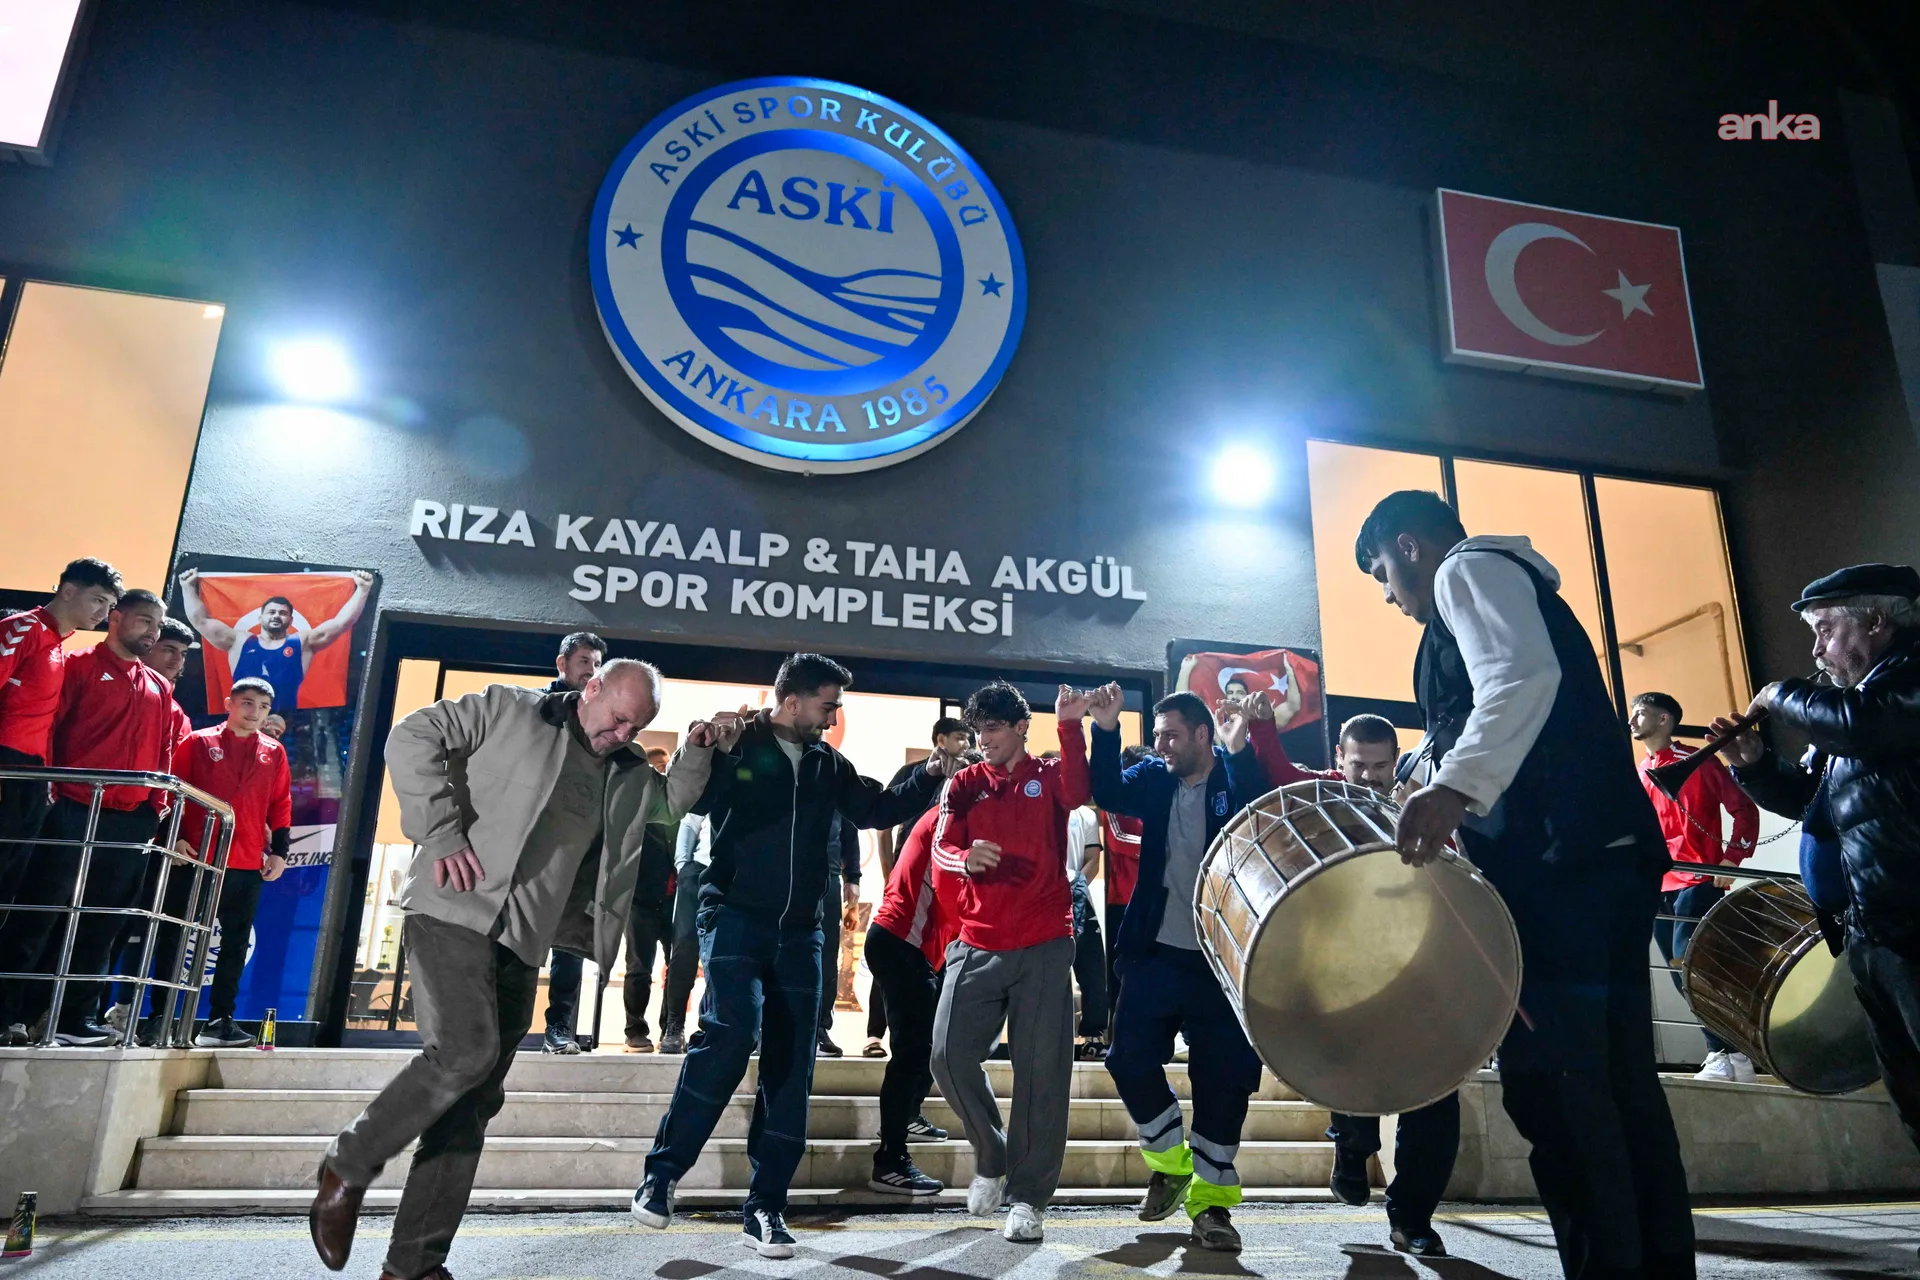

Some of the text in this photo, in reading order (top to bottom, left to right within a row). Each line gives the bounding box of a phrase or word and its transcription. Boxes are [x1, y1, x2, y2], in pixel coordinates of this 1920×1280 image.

[649, 95, 990, 228] ASKİ SPOR KULÜBÜ
[726, 169, 896, 234] ASKİ
[661, 349, 950, 433] ANKARA 1985
[409, 499, 536, 548] RIZA
[555, 513, 790, 568] KAYAALP
[845, 540, 971, 586] TAHA
[990, 554, 1148, 601] AKGÜL
[568, 564, 1013, 638] SPOR KOMPLEKSİ
